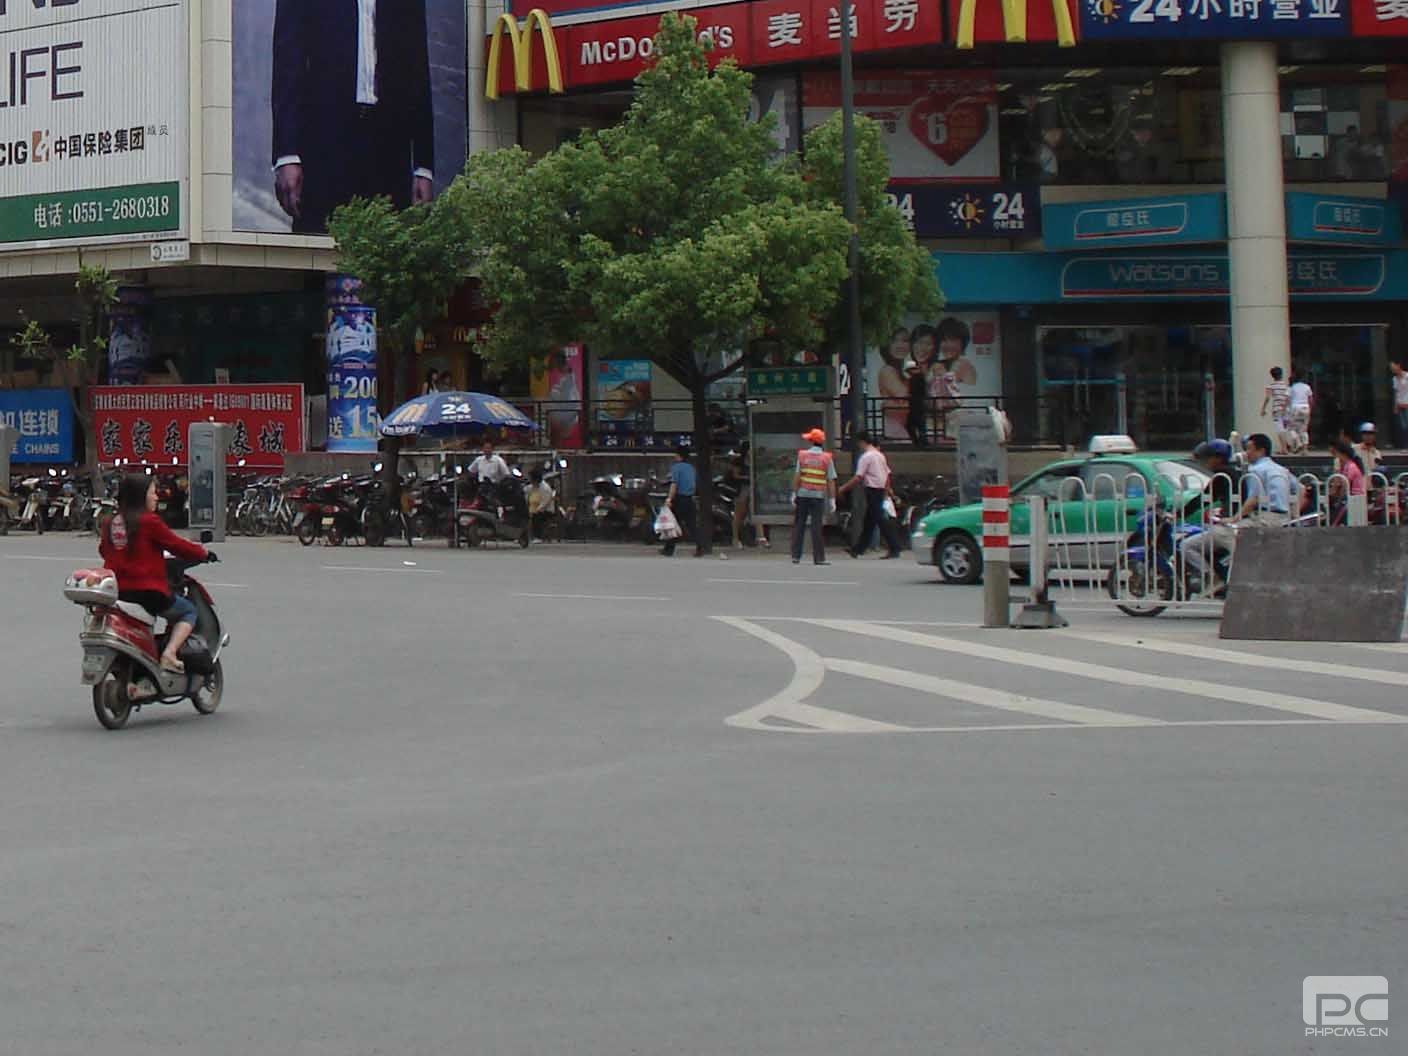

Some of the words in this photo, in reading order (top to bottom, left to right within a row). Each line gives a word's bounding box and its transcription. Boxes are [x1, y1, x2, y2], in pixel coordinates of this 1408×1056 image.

[580, 25, 734, 66] McDod's
[53, 125, 145, 160] 中国保险集团
[992, 192, 1025, 220] 24
[441, 403, 472, 416] 24
[24, 442, 60, 455] CHAINS
